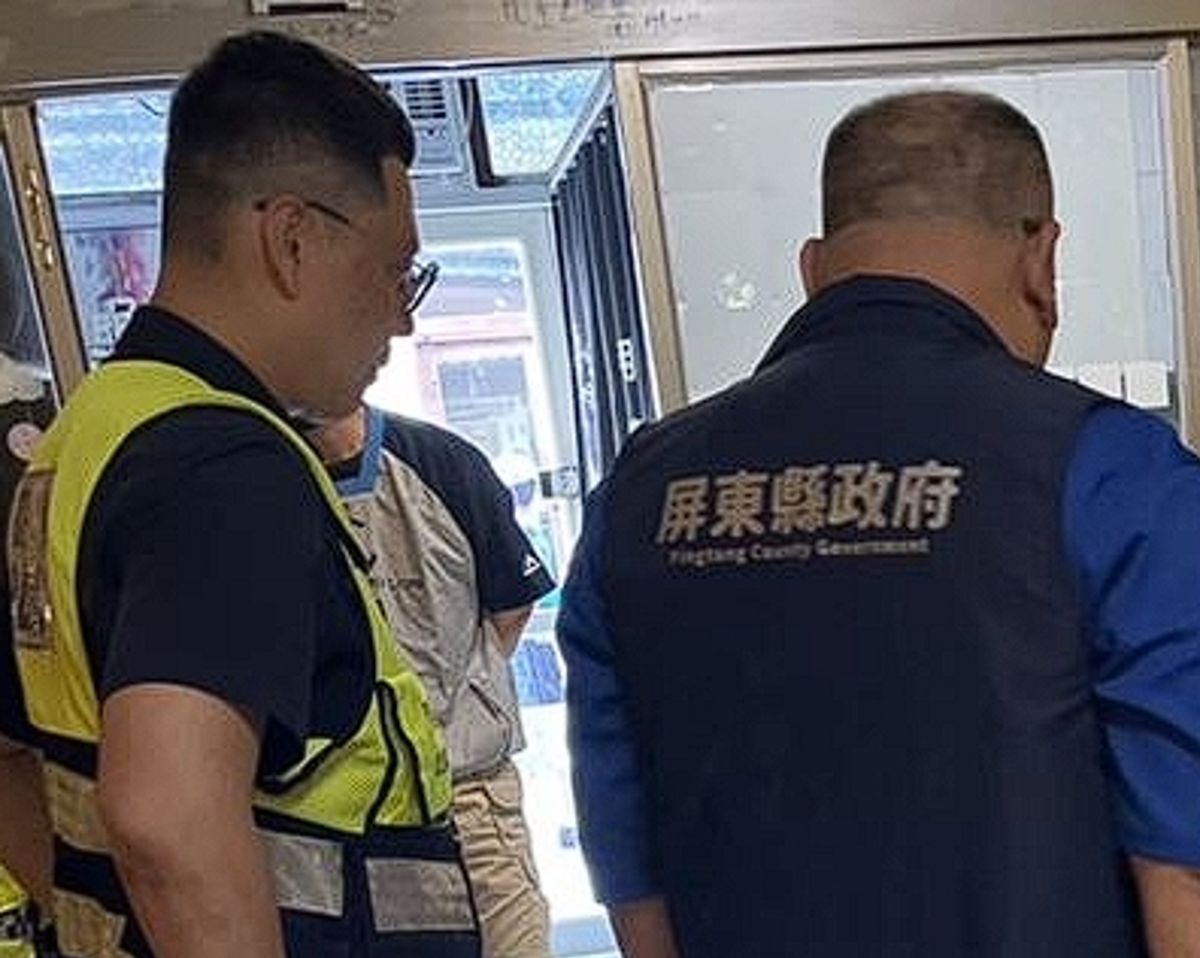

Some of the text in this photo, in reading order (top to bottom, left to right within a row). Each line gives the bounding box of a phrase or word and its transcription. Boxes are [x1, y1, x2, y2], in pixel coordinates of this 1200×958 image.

[656, 459, 963, 544] 屏東縣政府
[815, 538, 930, 555] Government
